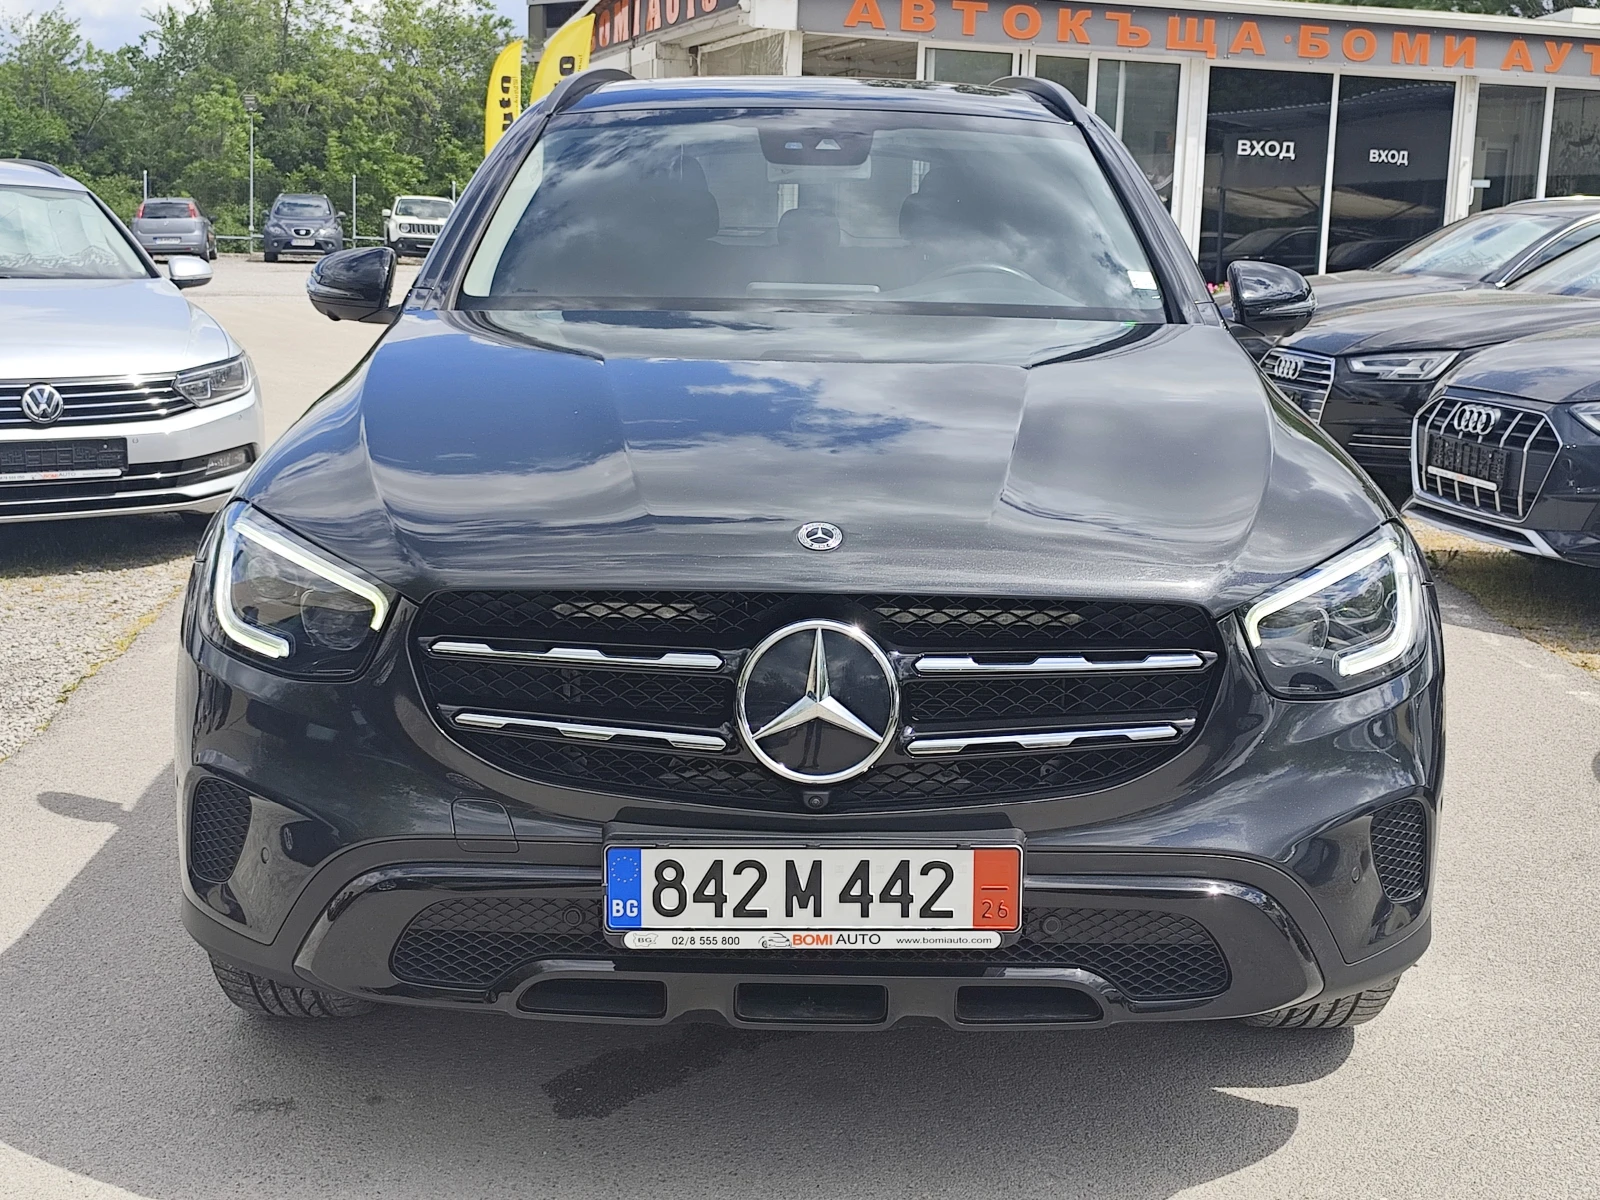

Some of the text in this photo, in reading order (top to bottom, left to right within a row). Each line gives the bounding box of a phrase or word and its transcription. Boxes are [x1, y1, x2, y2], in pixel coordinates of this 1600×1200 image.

[646, 0, 718, 32] AU
[843, 0, 1267, 58] АВТОКЪЩА
[1298, 25, 1477, 68] БОМИ
[1237, 139, 1296, 160] ВХОД
[1369, 149, 1409, 166] ВХОД
[652, 859, 955, 919] 842 M 442
[612, 899, 639, 917] BG
[981, 899, 1009, 918] 26
[671, 936, 740, 947] 02/8 555 800
[792, 933, 881, 946] BOMI AUTO
[895, 936, 992, 944] www.bomiauto.com
